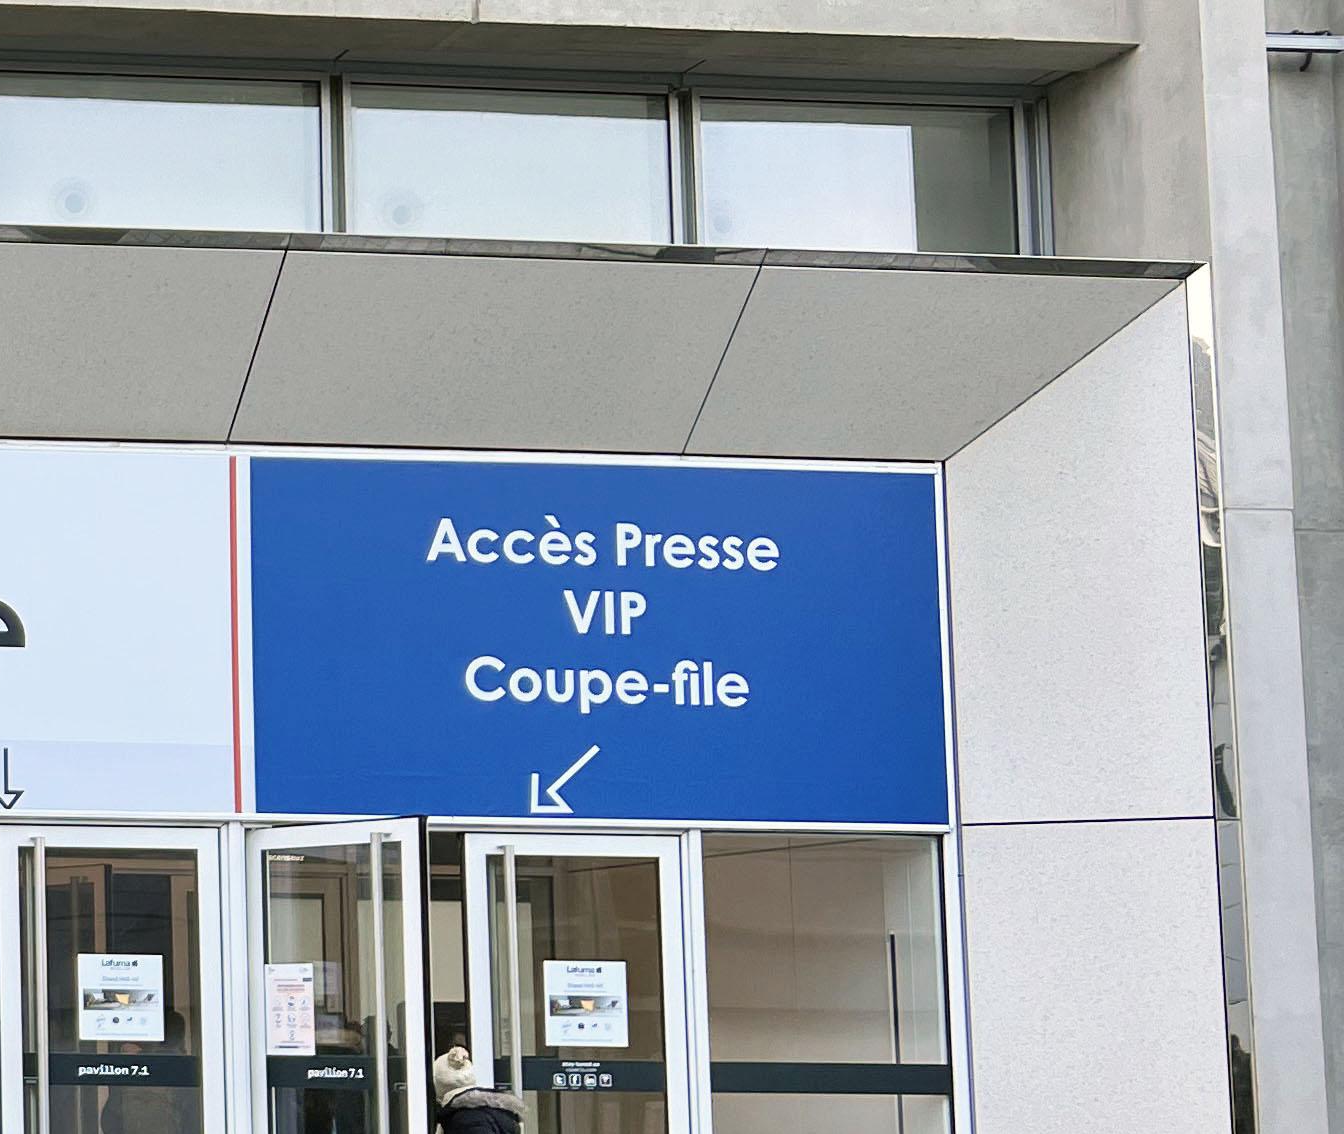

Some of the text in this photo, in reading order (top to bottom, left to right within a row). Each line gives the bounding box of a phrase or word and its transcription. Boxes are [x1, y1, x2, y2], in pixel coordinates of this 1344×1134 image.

[426, 514, 781, 572] Accès Presse
[563, 589, 648, 636] VIP
[464, 655, 750, 714] Coupe-file
[131, 1065, 150, 1076] 7.1
[349, 1067, 364, 1079] 7.1
